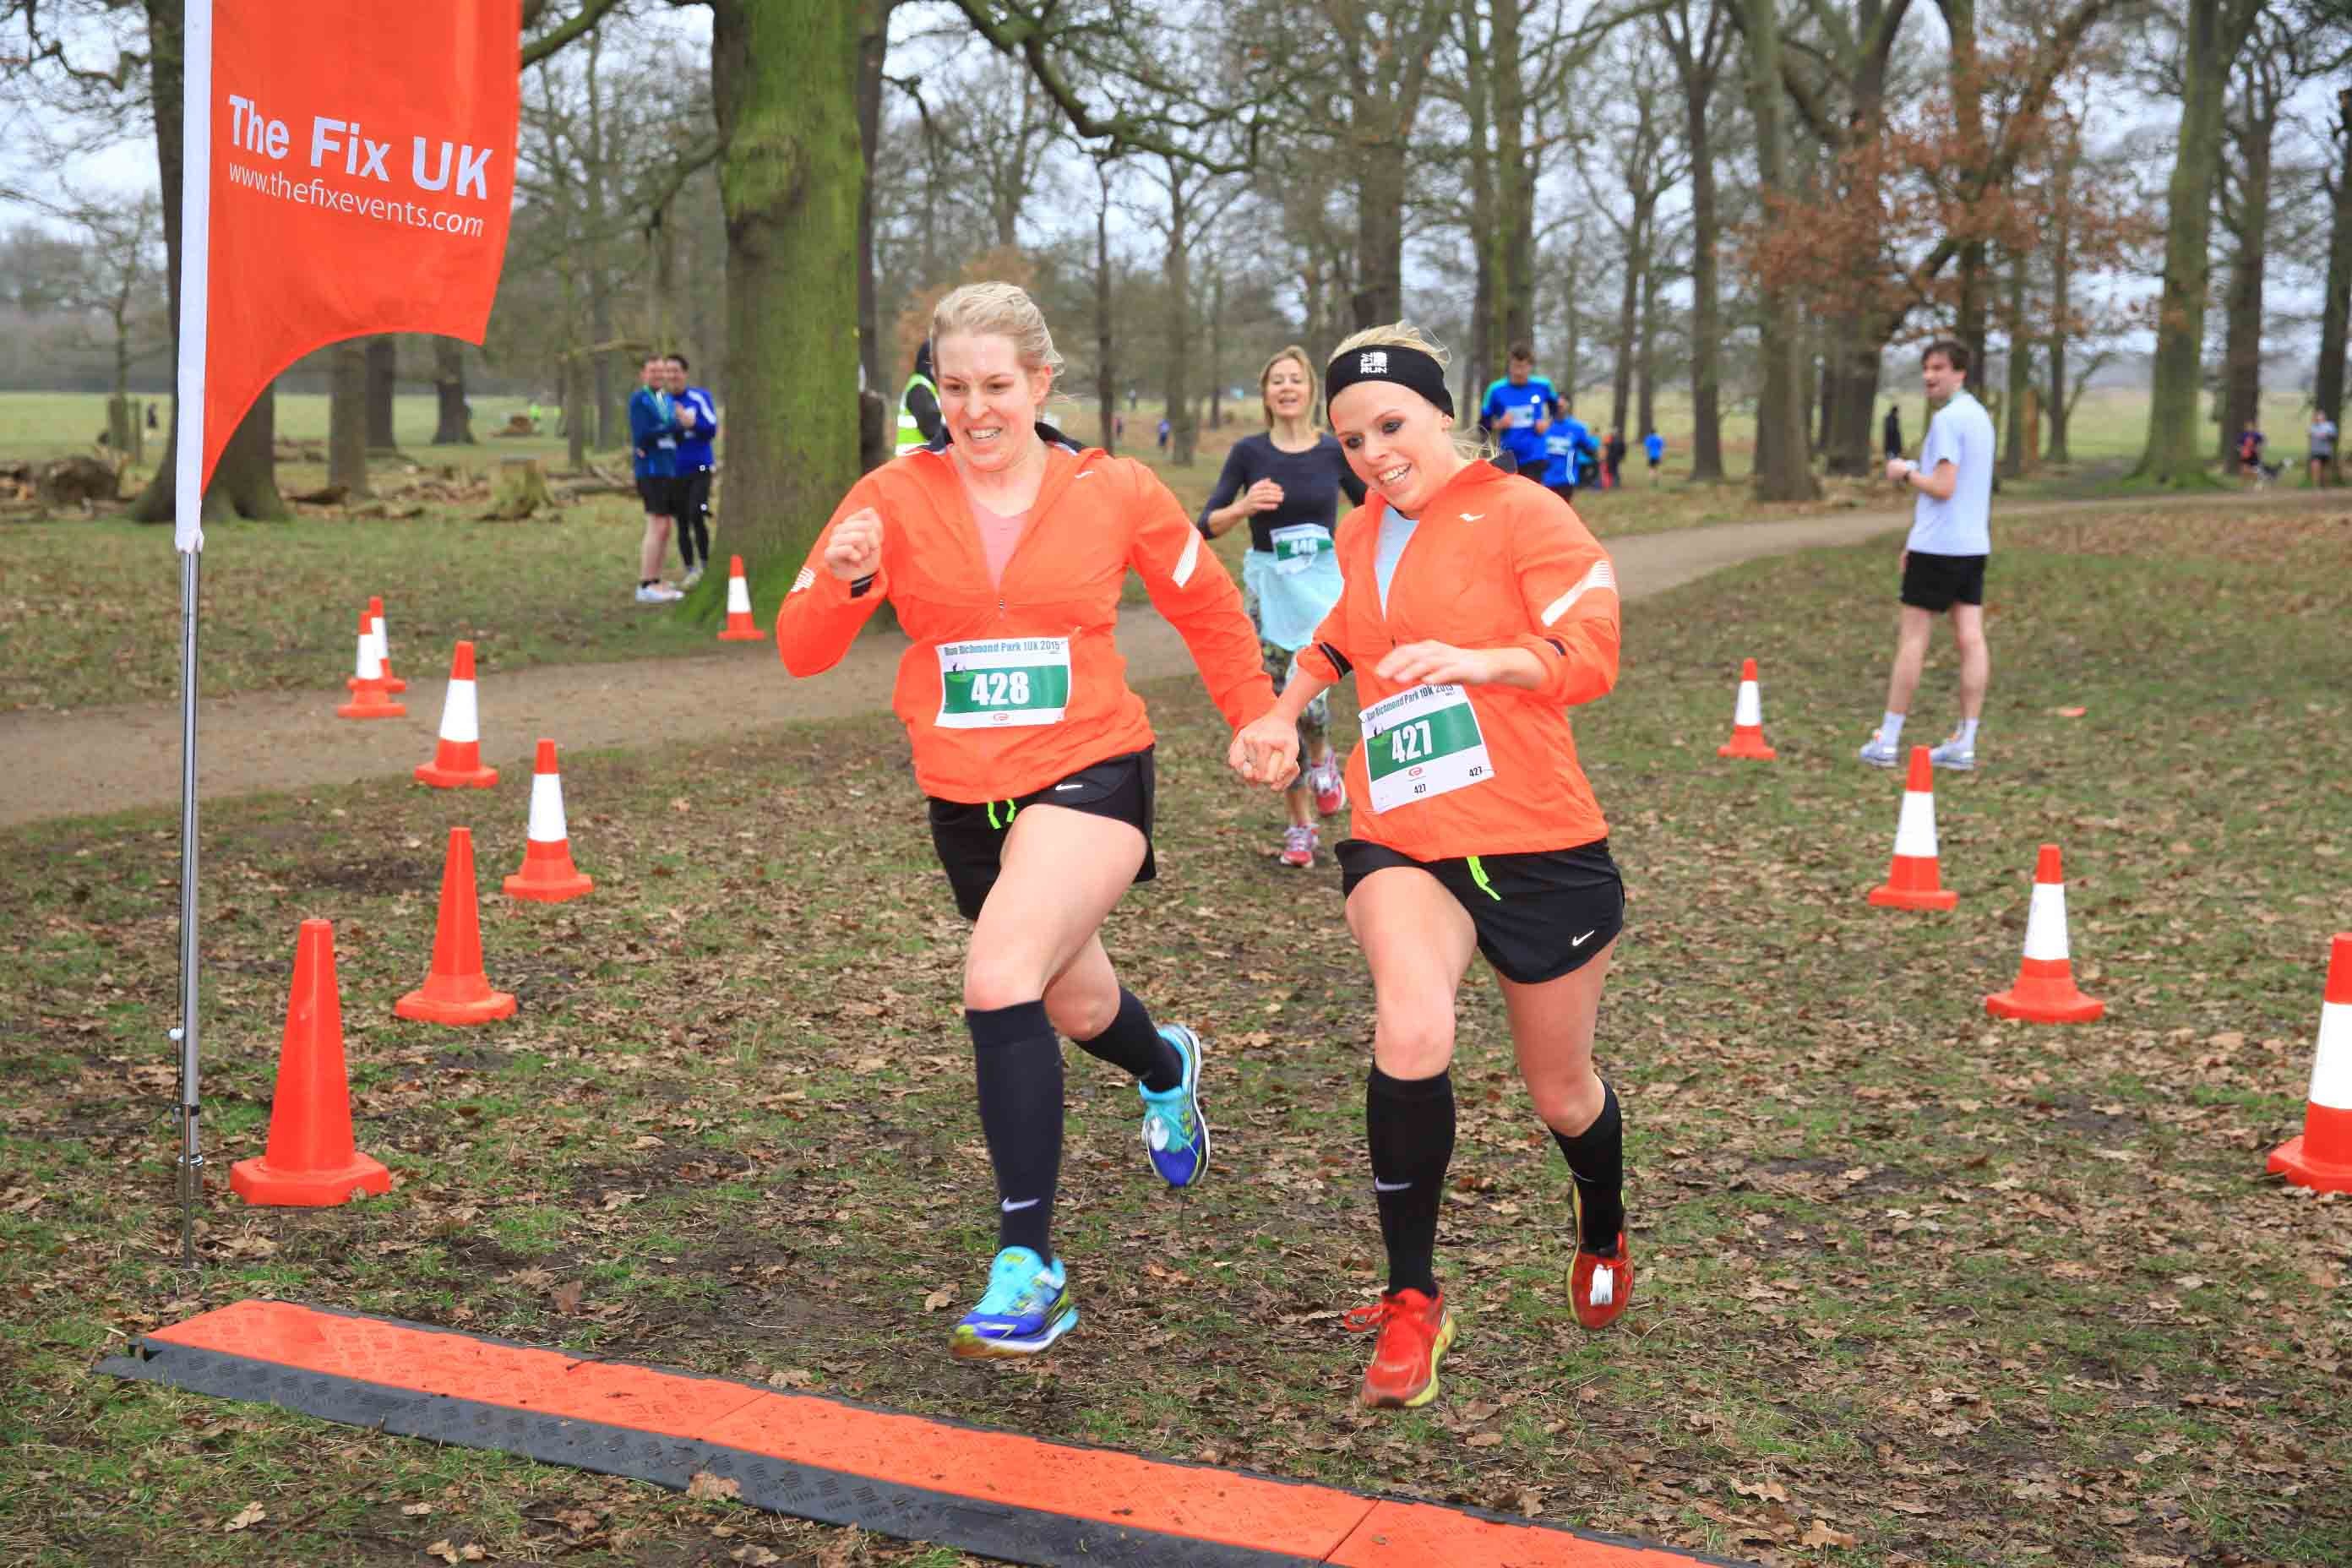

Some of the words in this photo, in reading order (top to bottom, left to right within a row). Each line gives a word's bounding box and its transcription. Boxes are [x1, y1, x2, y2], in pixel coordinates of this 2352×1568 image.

[229, 95, 290, 160] The
[311, 116, 392, 182] Fix
[412, 136, 493, 199] UK
[229, 162, 484, 237] www.thefixevents.com
[1001, 642, 1021, 651] Park
[1041, 640, 1059, 651] 2015
[971, 671, 1030, 705] 428
[1375, 696, 1404, 716] Richmond
[1404, 689, 1419, 704] Park
[1391, 720, 1433, 763] 427
[1468, 766, 1483, 777] 427
[1413, 784, 1426, 794] 427
